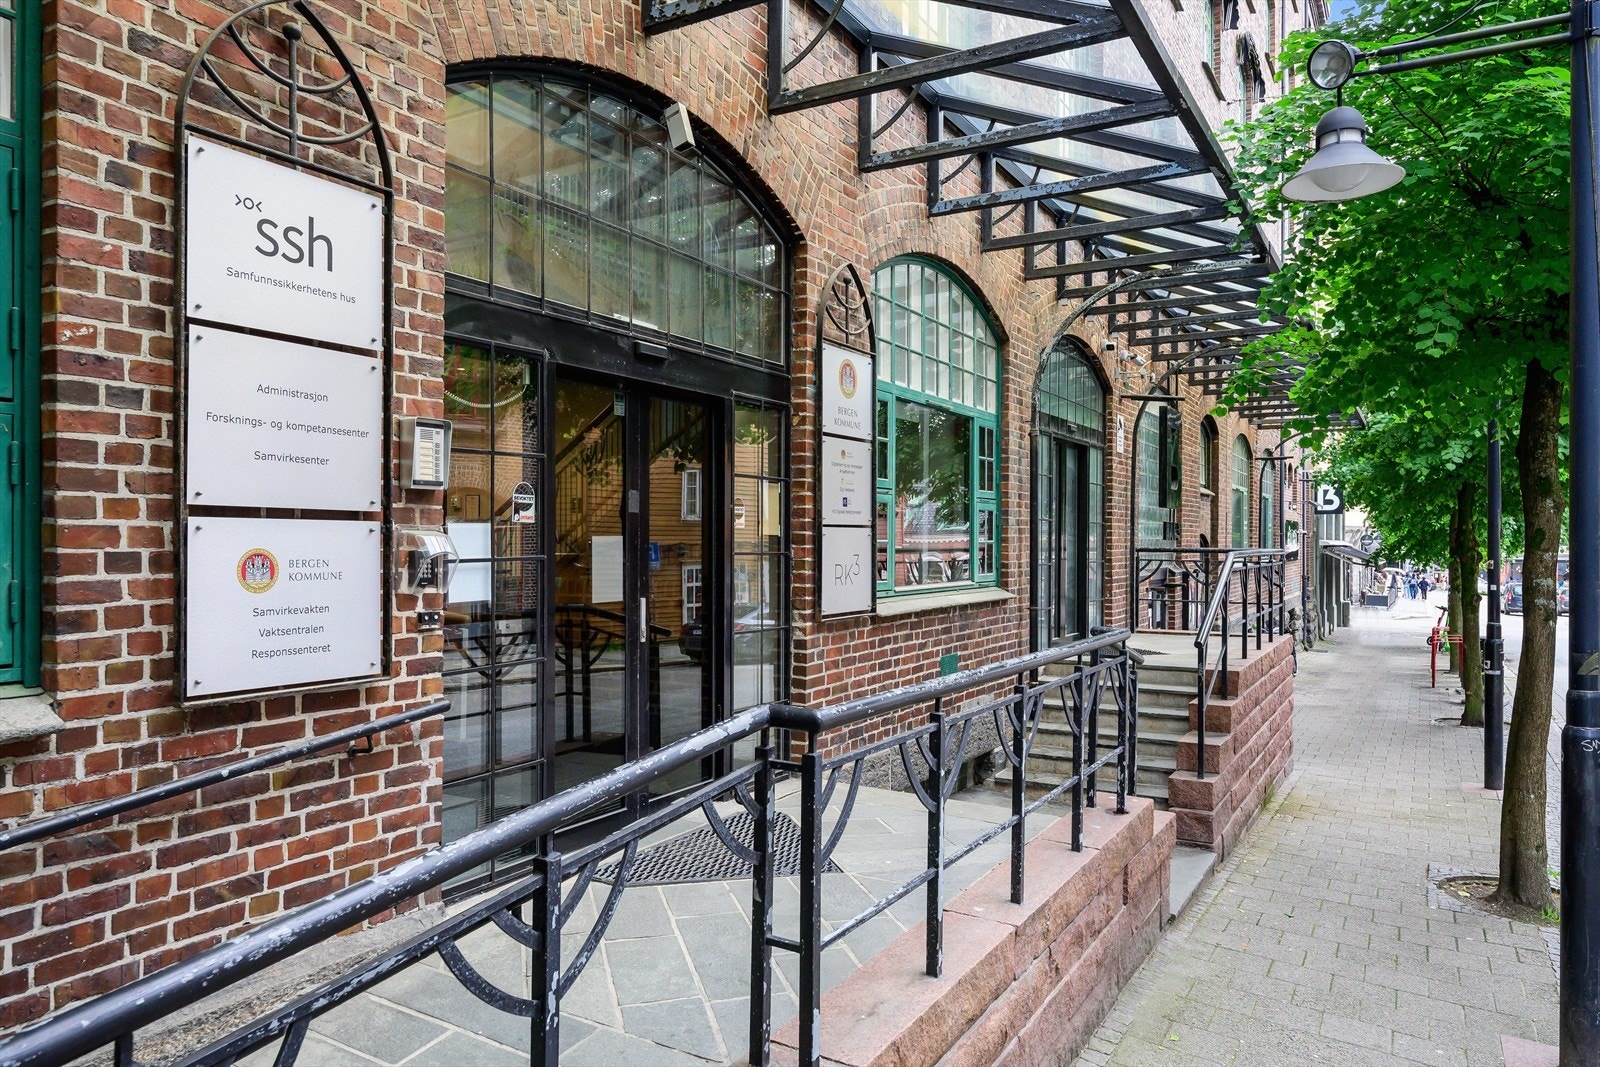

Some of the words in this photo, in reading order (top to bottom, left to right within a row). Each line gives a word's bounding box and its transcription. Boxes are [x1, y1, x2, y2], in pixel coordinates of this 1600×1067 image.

[255, 216, 332, 272] ssh
[226, 266, 337, 299] Samfunnssikkerhetens
[340, 292, 356, 304] hus
[257, 384, 328, 402] Administrasjon
[838, 406, 858, 418] BERGEN
[206, 411, 266, 428] Forsknings-
[270, 420, 283, 430] og
[286, 421, 369, 438] kompetansesenter
[834, 417, 861, 431] KOMMUNE
[254, 451, 329, 466] Samvirkesenter
[288, 559, 330, 569] BERGEN
[288, 571, 343, 582] KOMMUNE
[253, 605, 330, 617] Samvirkevakten
[259, 625, 324, 637] Vaktsentralen
[251, 644, 331, 659] Responssenteret
